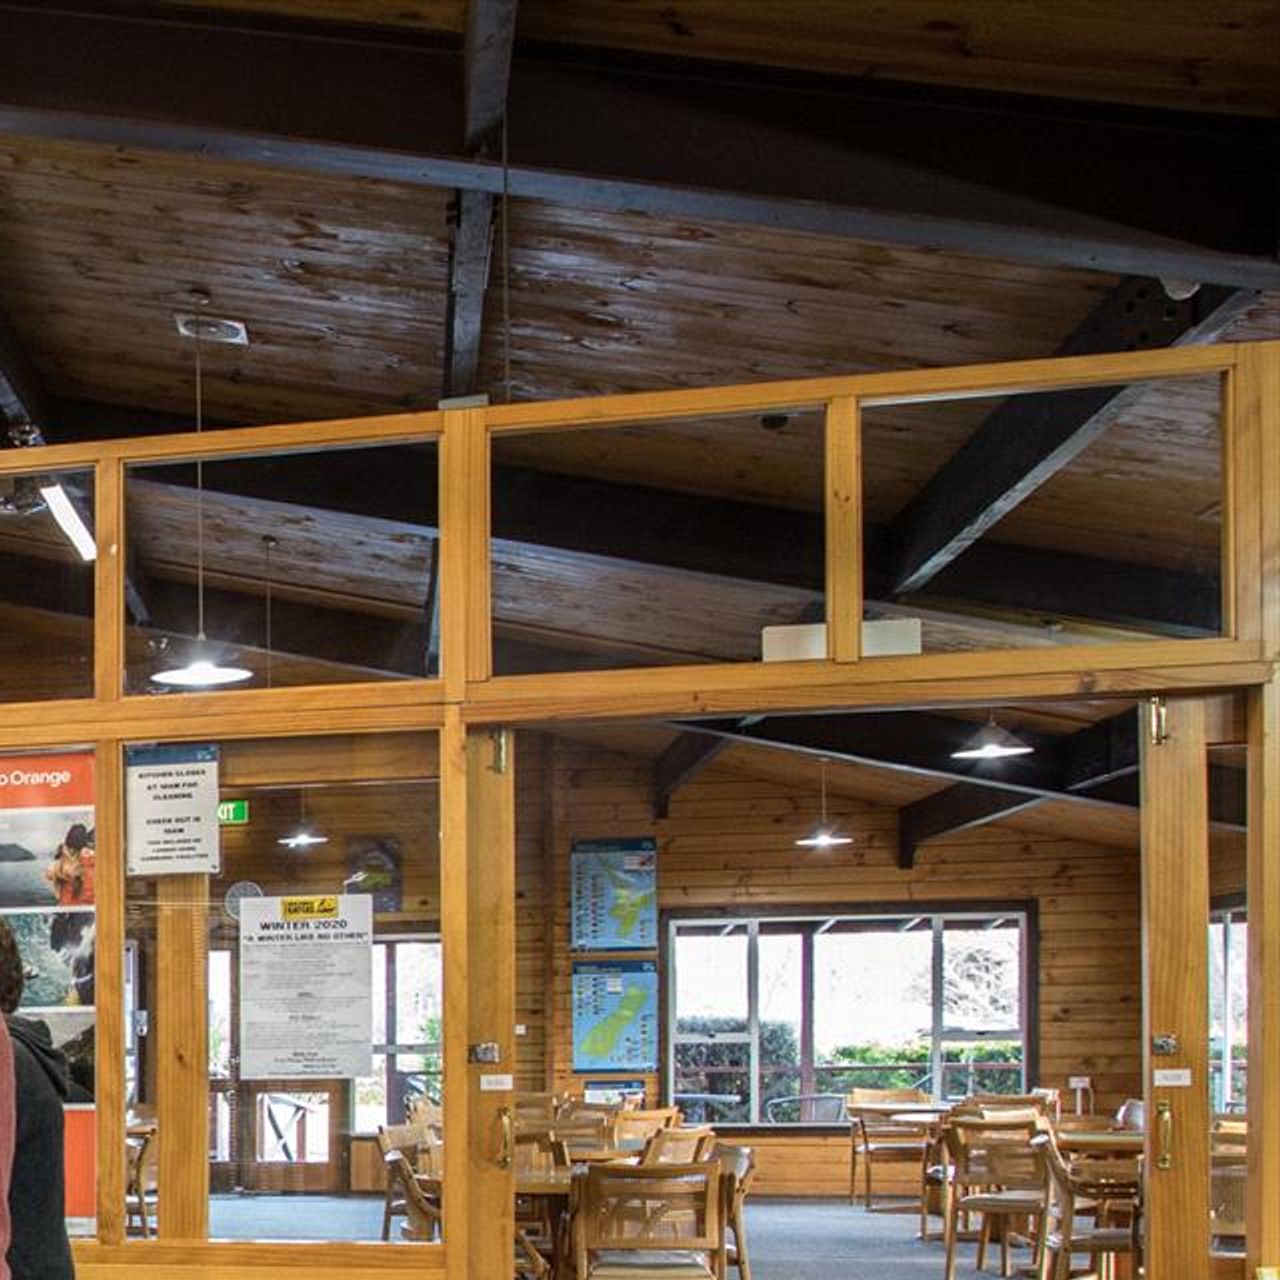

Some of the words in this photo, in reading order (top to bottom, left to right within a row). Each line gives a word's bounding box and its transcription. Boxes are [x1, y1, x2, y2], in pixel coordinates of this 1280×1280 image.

[10, 770, 71, 788] Orange
[260, 921, 309, 931] WINTER
[314, 919, 348, 929] 2020
[257, 933, 292, 942] WINTER
